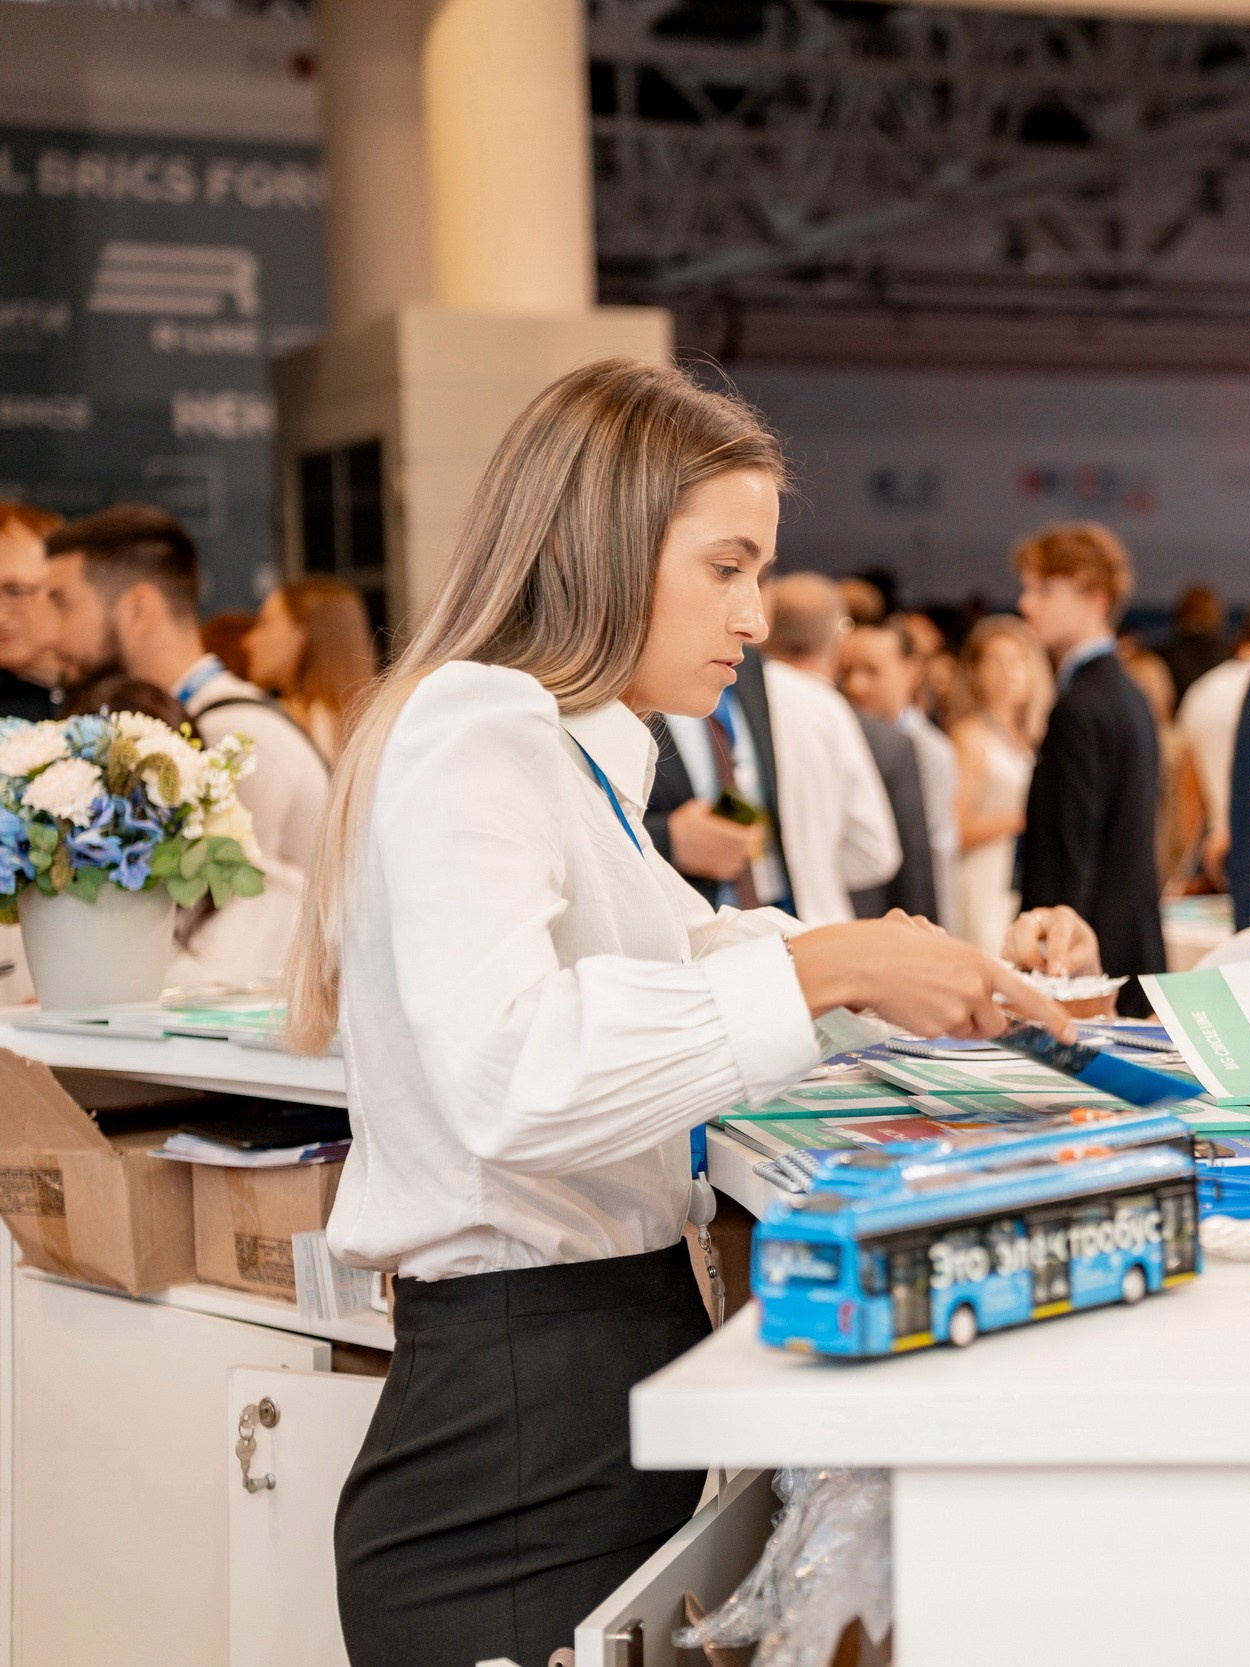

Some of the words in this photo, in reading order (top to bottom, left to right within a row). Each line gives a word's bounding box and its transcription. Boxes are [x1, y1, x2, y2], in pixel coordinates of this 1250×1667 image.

[36, 150, 197, 204] BRICS
[1191, 1010, 1213, 1029] LINE
[1201, 1028, 1229, 1056] CIRCLE
[928, 1241, 990, 1290] Это
[995, 1207, 1163, 1276] электробус
